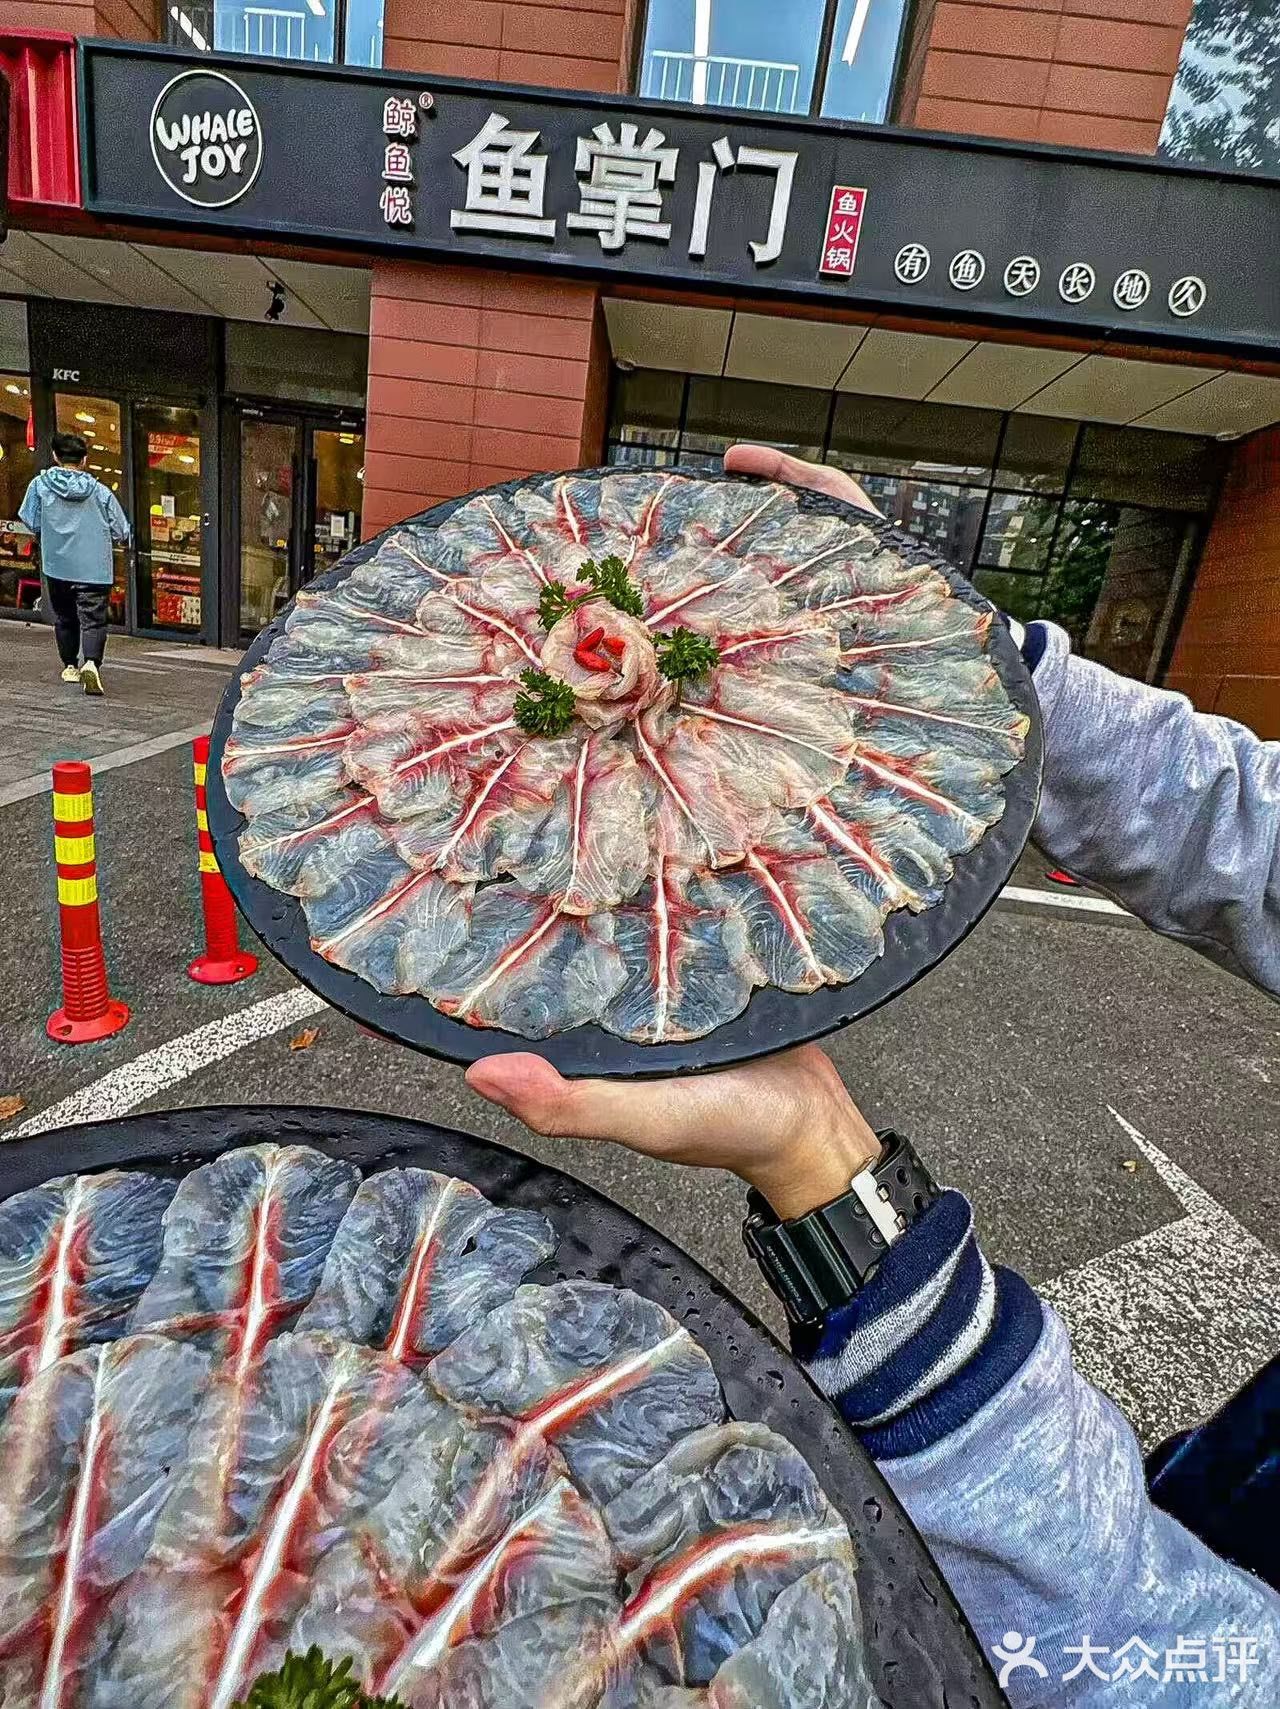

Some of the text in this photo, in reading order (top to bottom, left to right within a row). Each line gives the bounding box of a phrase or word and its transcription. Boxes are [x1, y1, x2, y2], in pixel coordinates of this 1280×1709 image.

[156, 109, 254, 151] WHALE
[180, 142, 247, 184] JOY
[380, 97, 416, 225] 鲸鱼悦
[450, 112, 799, 264] 鱼掌门
[826, 192, 859, 272] 鱼火锅
[895, 243, 1206, 317] 有鱼天长地久
[52, 368, 80, 382] KFC
